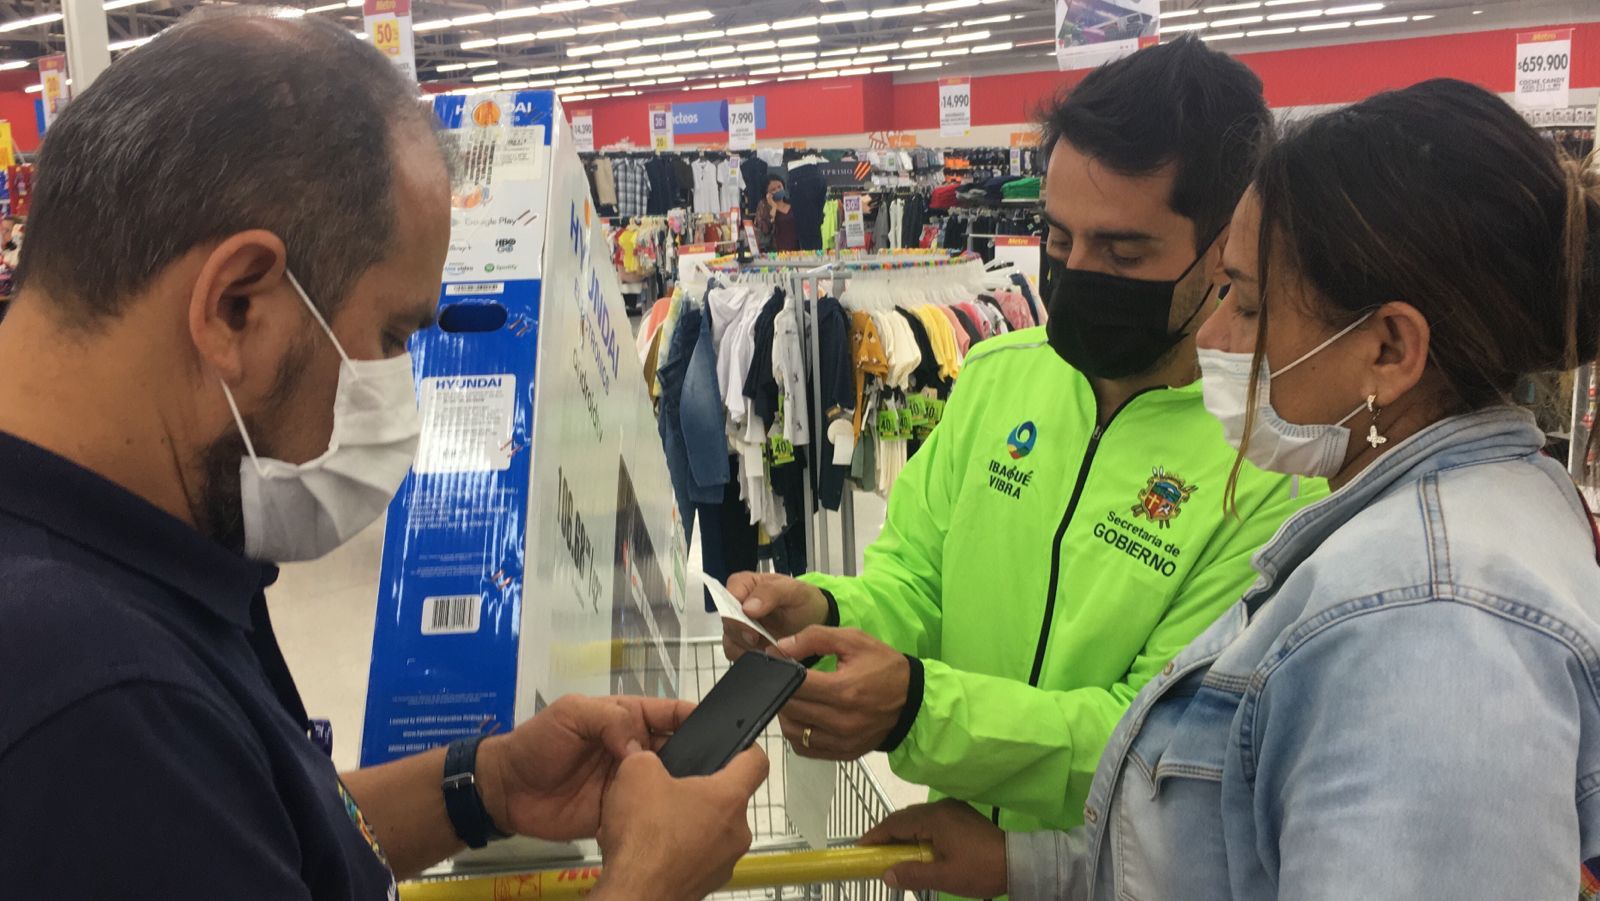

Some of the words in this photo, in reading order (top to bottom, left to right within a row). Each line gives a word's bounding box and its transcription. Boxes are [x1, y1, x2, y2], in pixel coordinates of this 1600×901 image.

[1518, 54, 1568, 73] $659.900
[989, 474, 1022, 500] VIBRA
[1093, 522, 1177, 577] GOBIERNO
[1107, 510, 1163, 548] Secretaría
[1164, 543, 1181, 557] de
